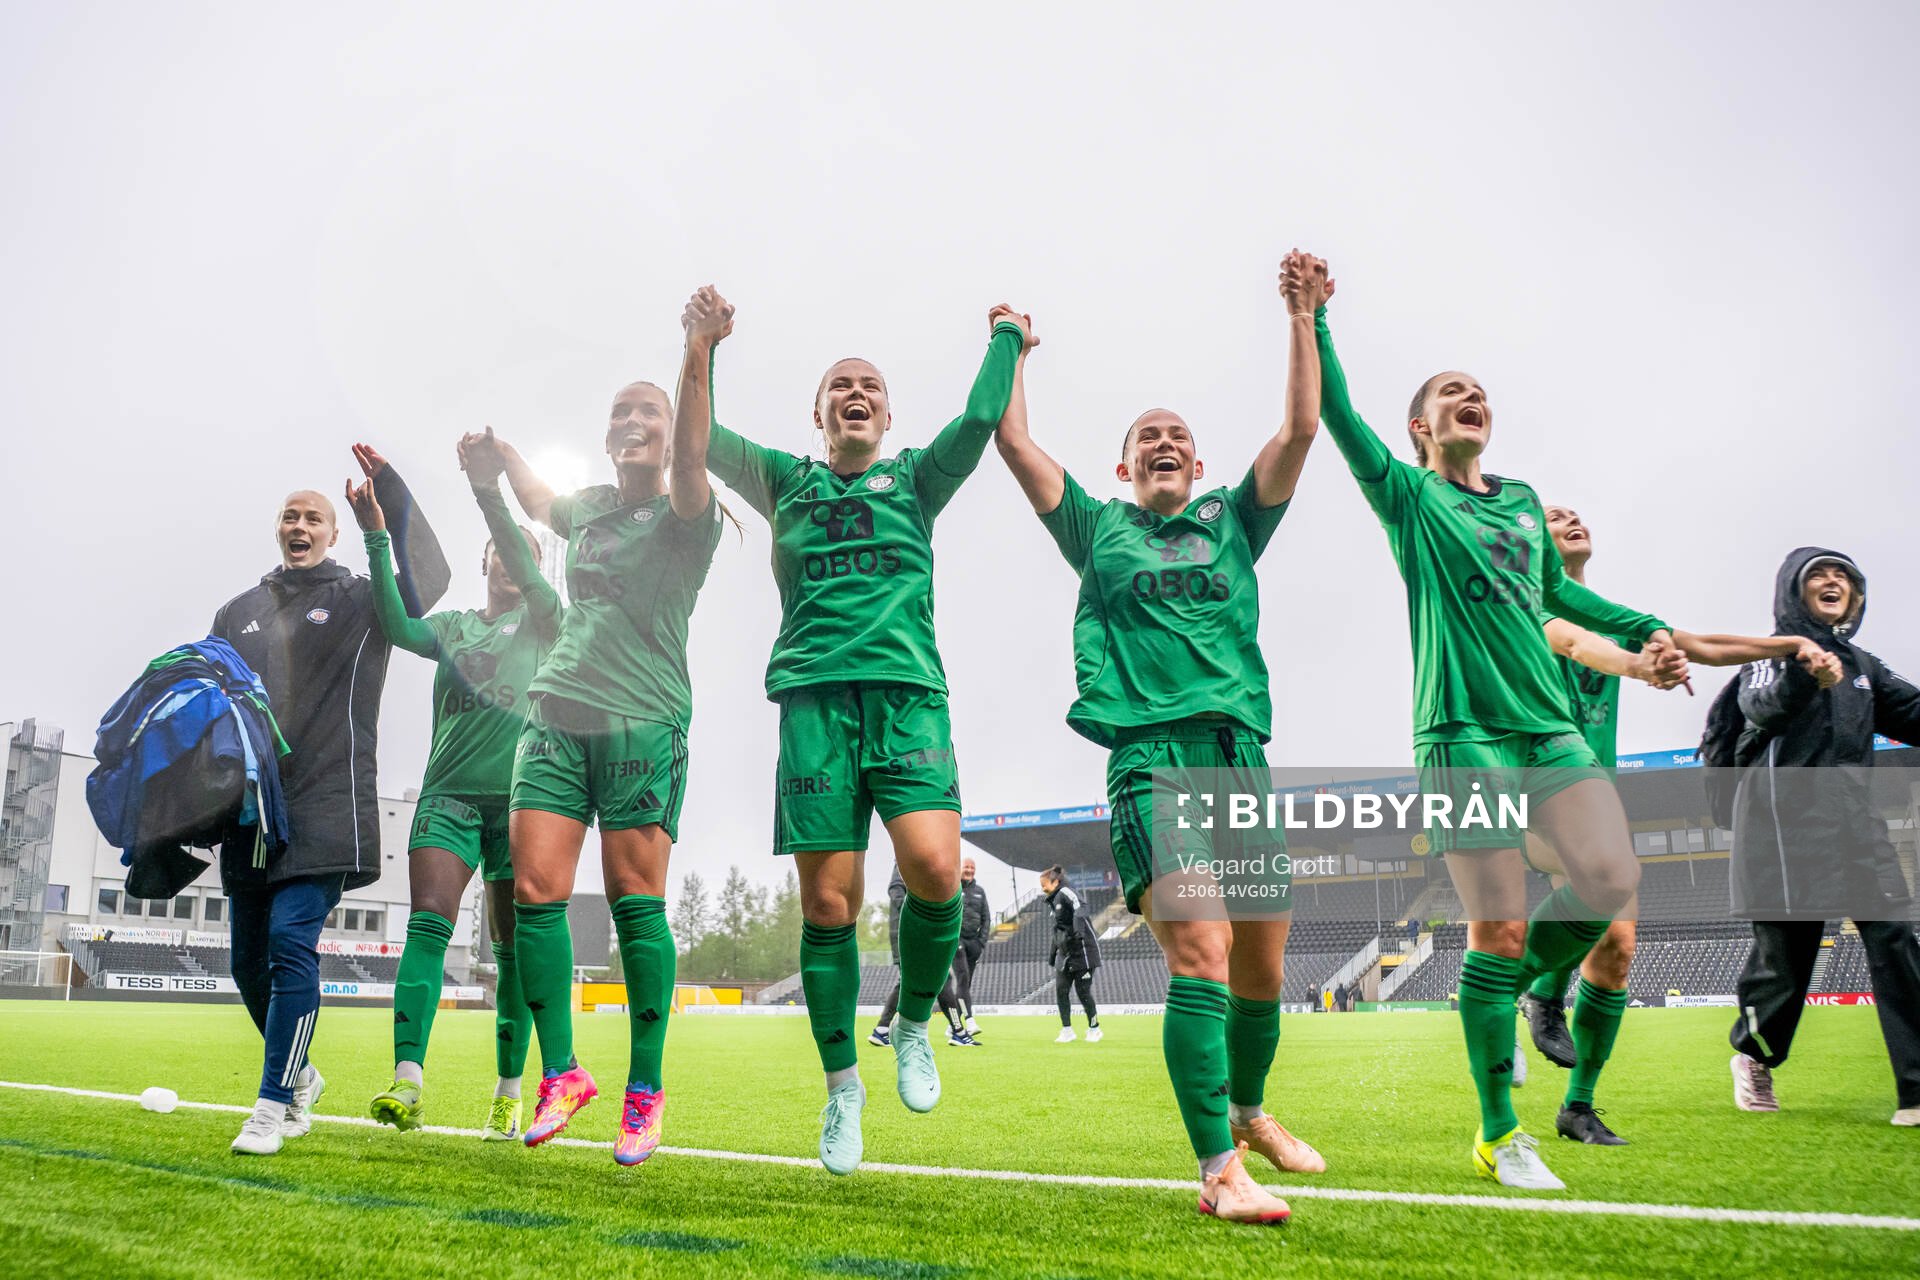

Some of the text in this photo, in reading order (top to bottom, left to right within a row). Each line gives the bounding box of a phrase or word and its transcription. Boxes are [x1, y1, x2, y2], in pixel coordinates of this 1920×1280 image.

[805, 546, 902, 582] OBOS
[1132, 569, 1230, 601] OBOS
[445, 685, 514, 715] OBOS
[889, 748, 950, 770] STERK
[783, 776, 833, 796] STERK
[1328, 785, 1373, 795] Nord-Norge
[415, 816, 430, 837] 14
[355, 943, 379, 952] INFRA
[116, 976, 163, 989] TESS
[172, 979, 217, 990] TESS
[323, 984, 358, 994] an.no
